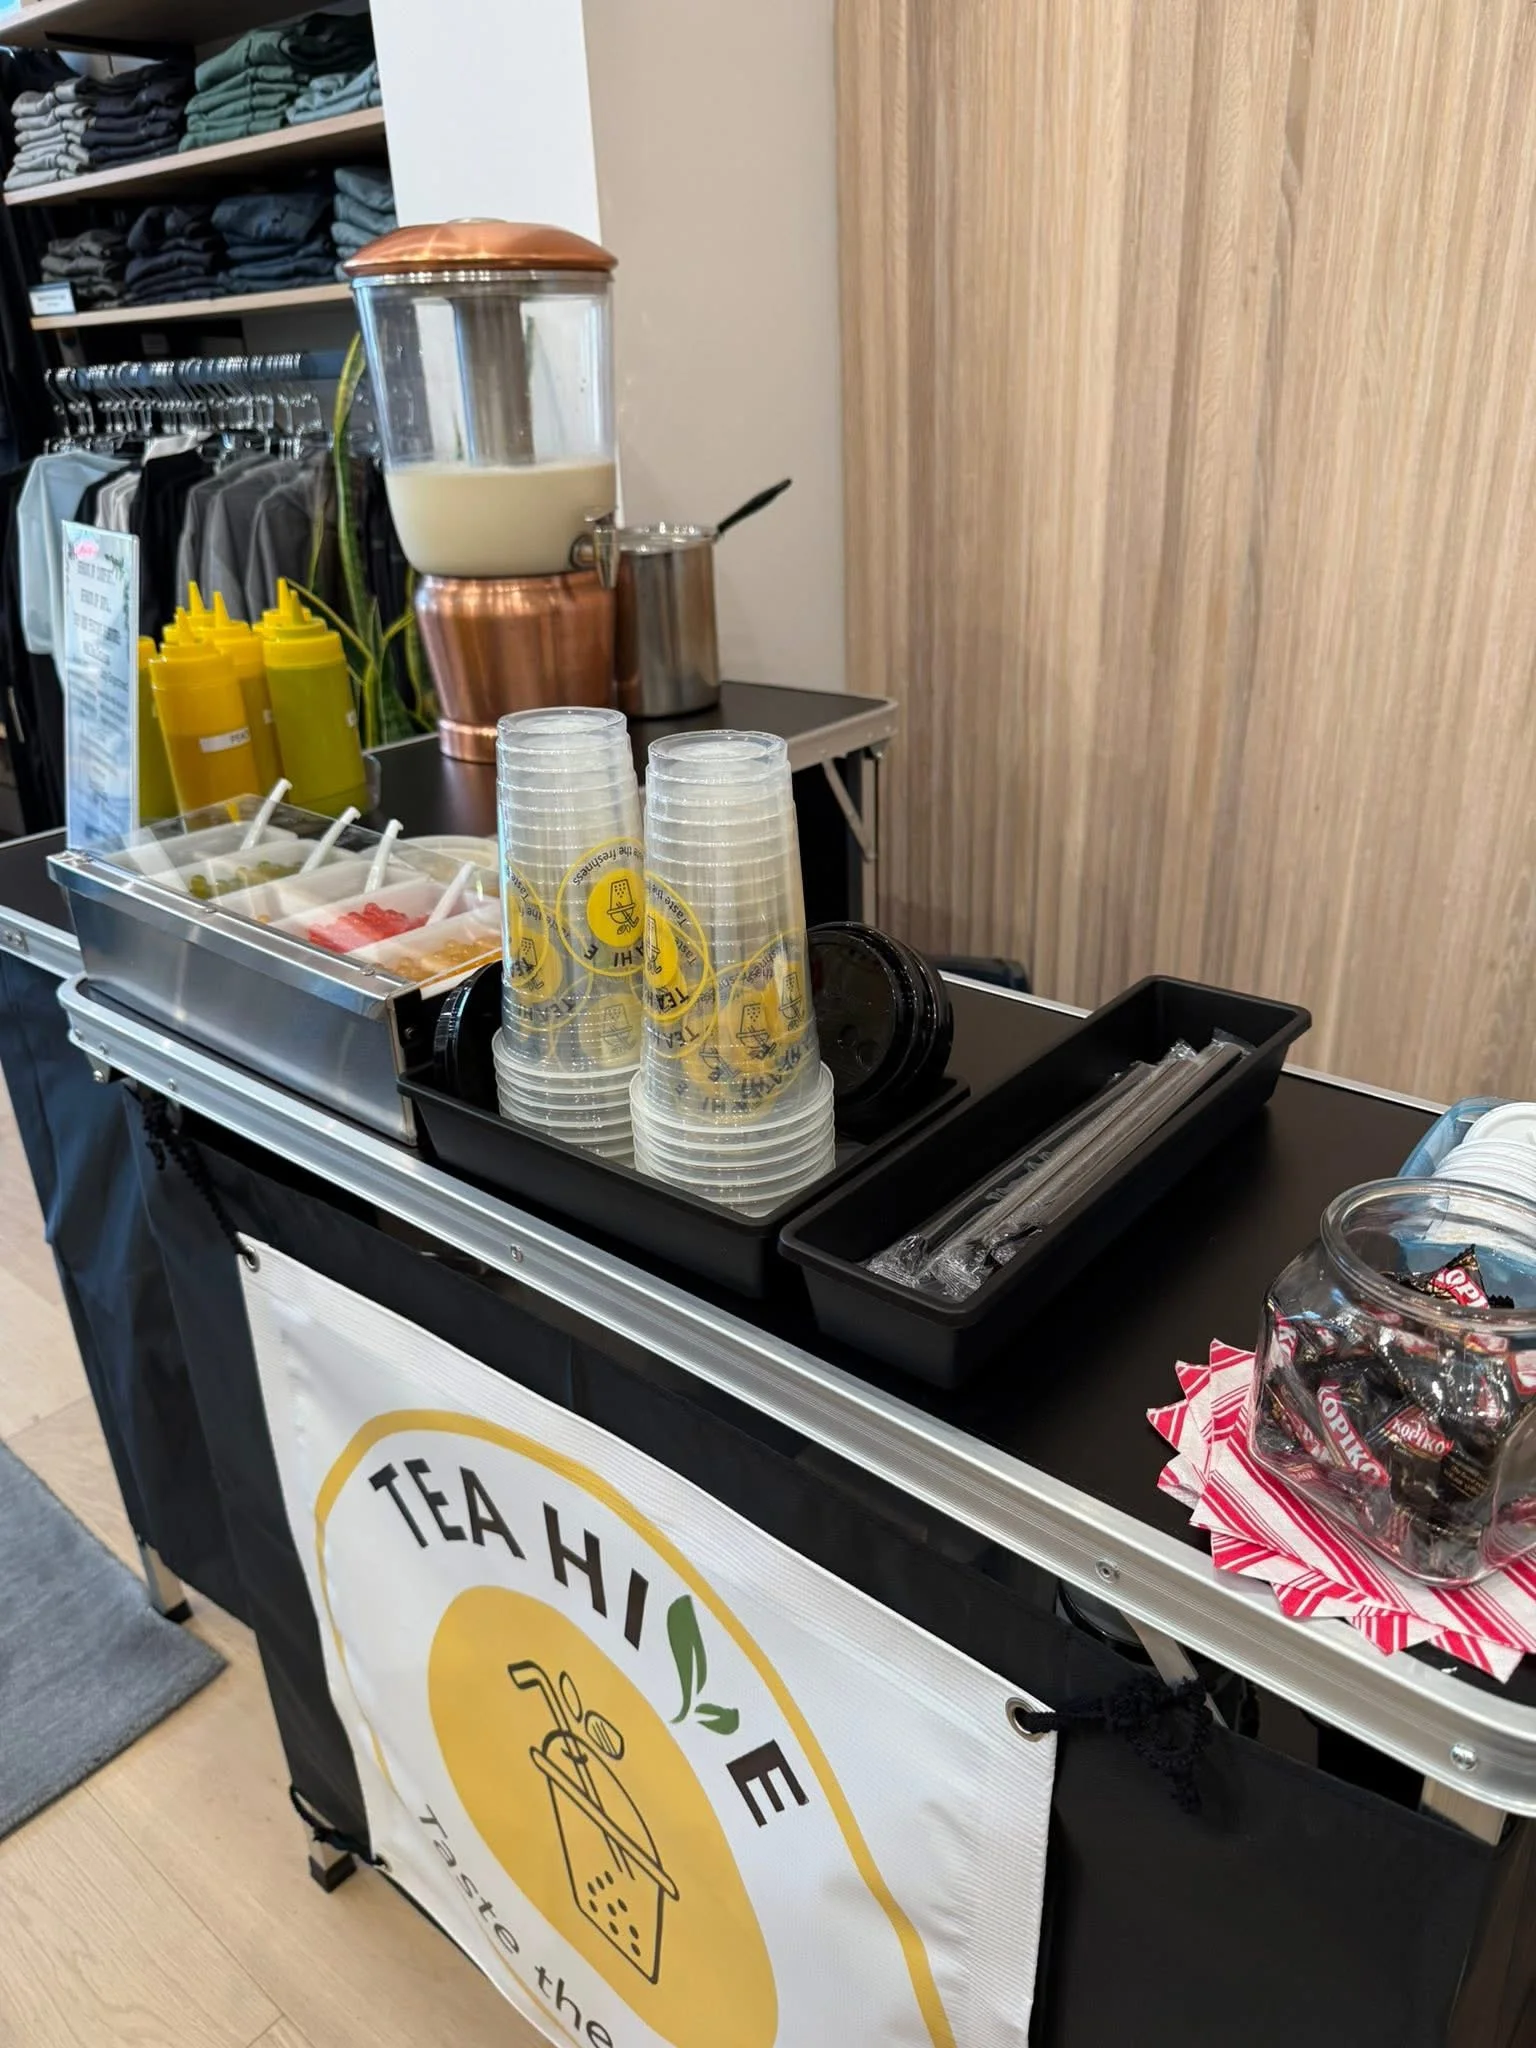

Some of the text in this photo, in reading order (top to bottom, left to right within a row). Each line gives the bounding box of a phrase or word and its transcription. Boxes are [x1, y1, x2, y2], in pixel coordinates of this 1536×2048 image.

[572, 848, 619, 887] freshness
[664, 896, 687, 927] Taste
[656, 987, 689, 1011] TEA
[368, 1457, 527, 1560] TEA
[417, 1803, 613, 2048] Taste the
